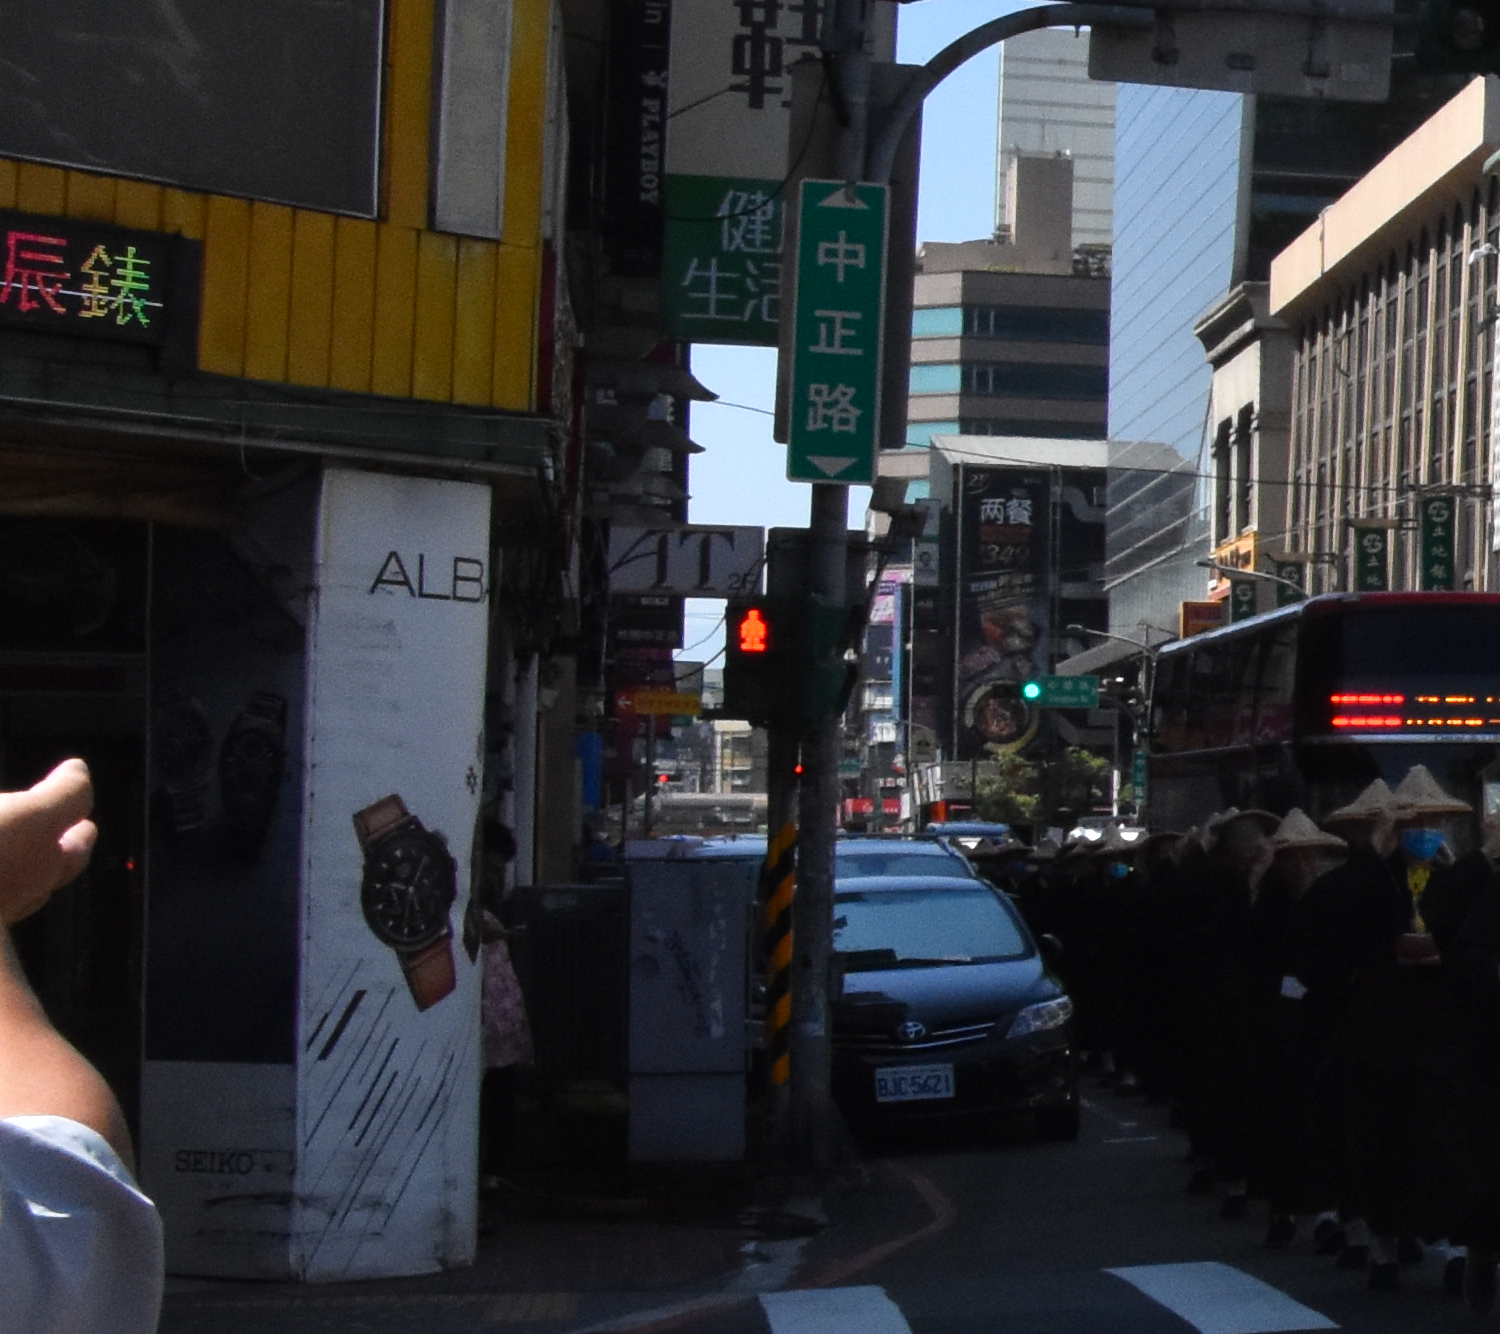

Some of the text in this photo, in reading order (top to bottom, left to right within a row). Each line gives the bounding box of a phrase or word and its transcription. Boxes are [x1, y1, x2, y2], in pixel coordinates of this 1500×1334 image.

[715, 189, 785, 254] 健
[804, 229, 869, 436] 中正路
[369, 550, 489, 603] ALB
[1430, 527, 1450, 593] 土地銀
[175, 1149, 255, 1175] SEIKO
